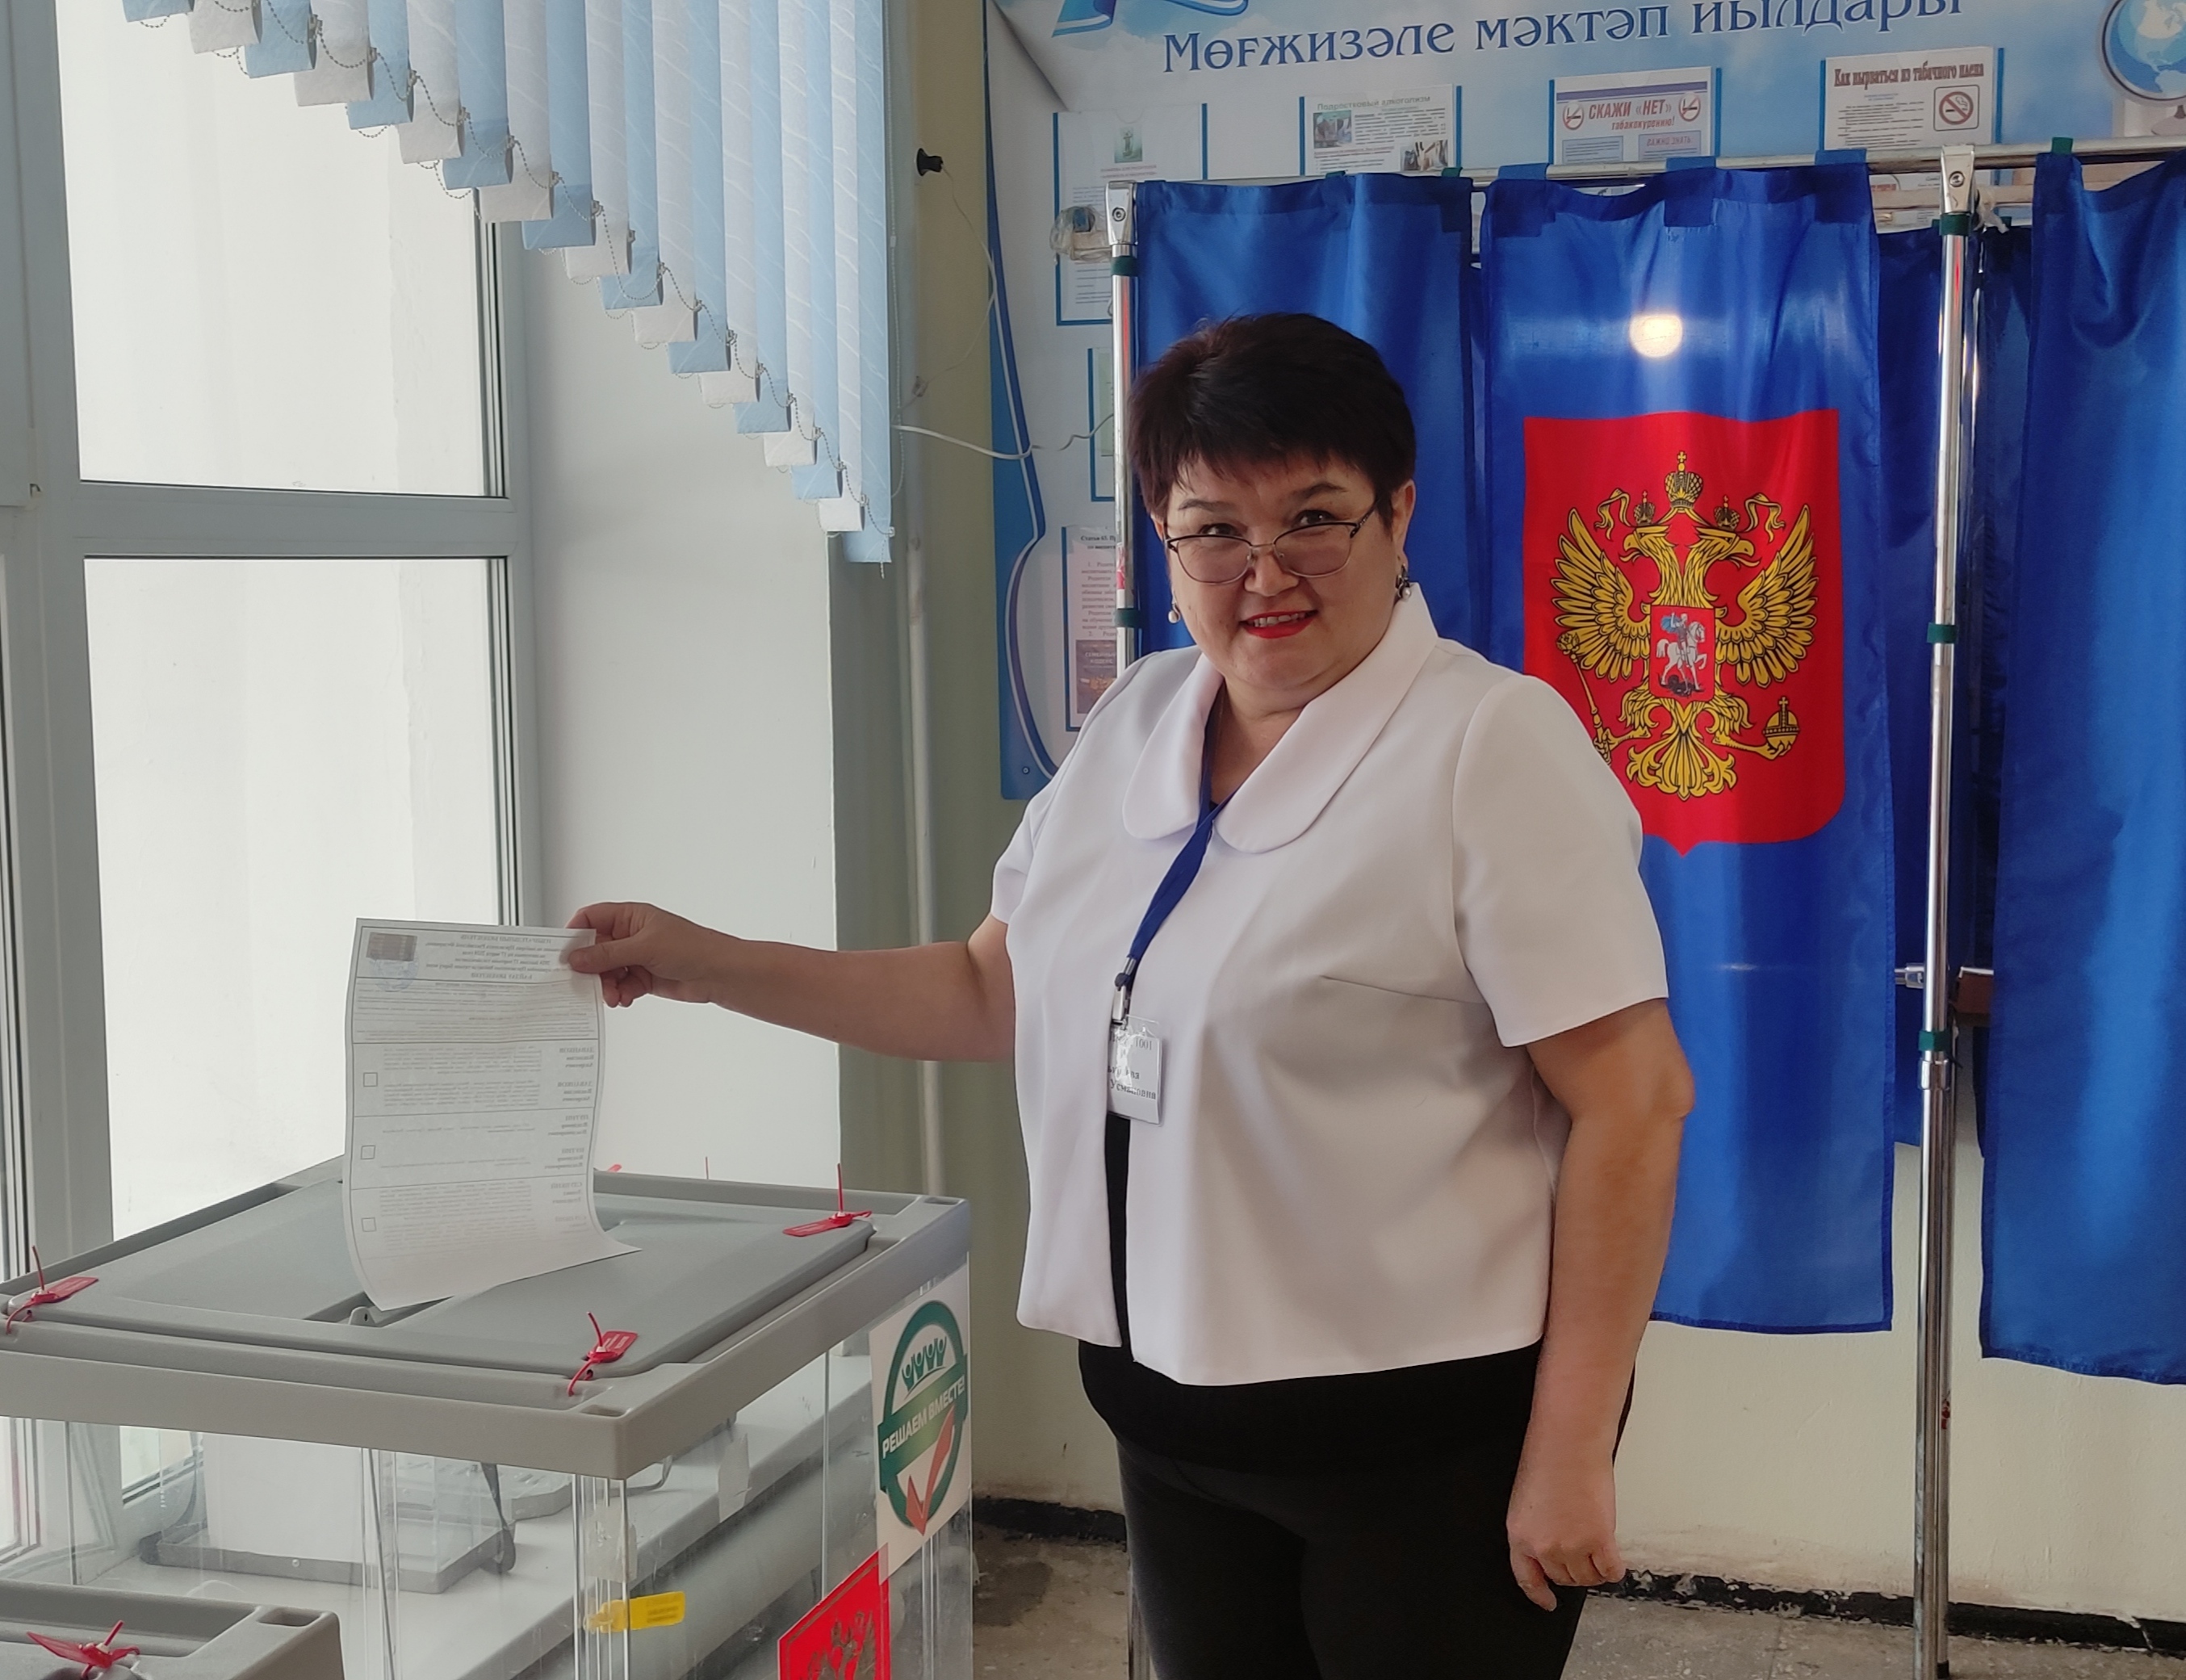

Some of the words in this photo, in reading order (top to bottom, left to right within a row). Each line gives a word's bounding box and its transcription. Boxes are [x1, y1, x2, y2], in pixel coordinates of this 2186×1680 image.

[1164, 23, 1455, 73] Мөғжизәле
[1475, 6, 1669, 50] мәктәп
[1834, 69, 1851, 86] Как
[1589, 102, 1631, 119] СКАЖИ
[882, 1407, 928, 1460] РЕШАЕМ
[928, 1374, 965, 1421] ВМЕСТЕ!
